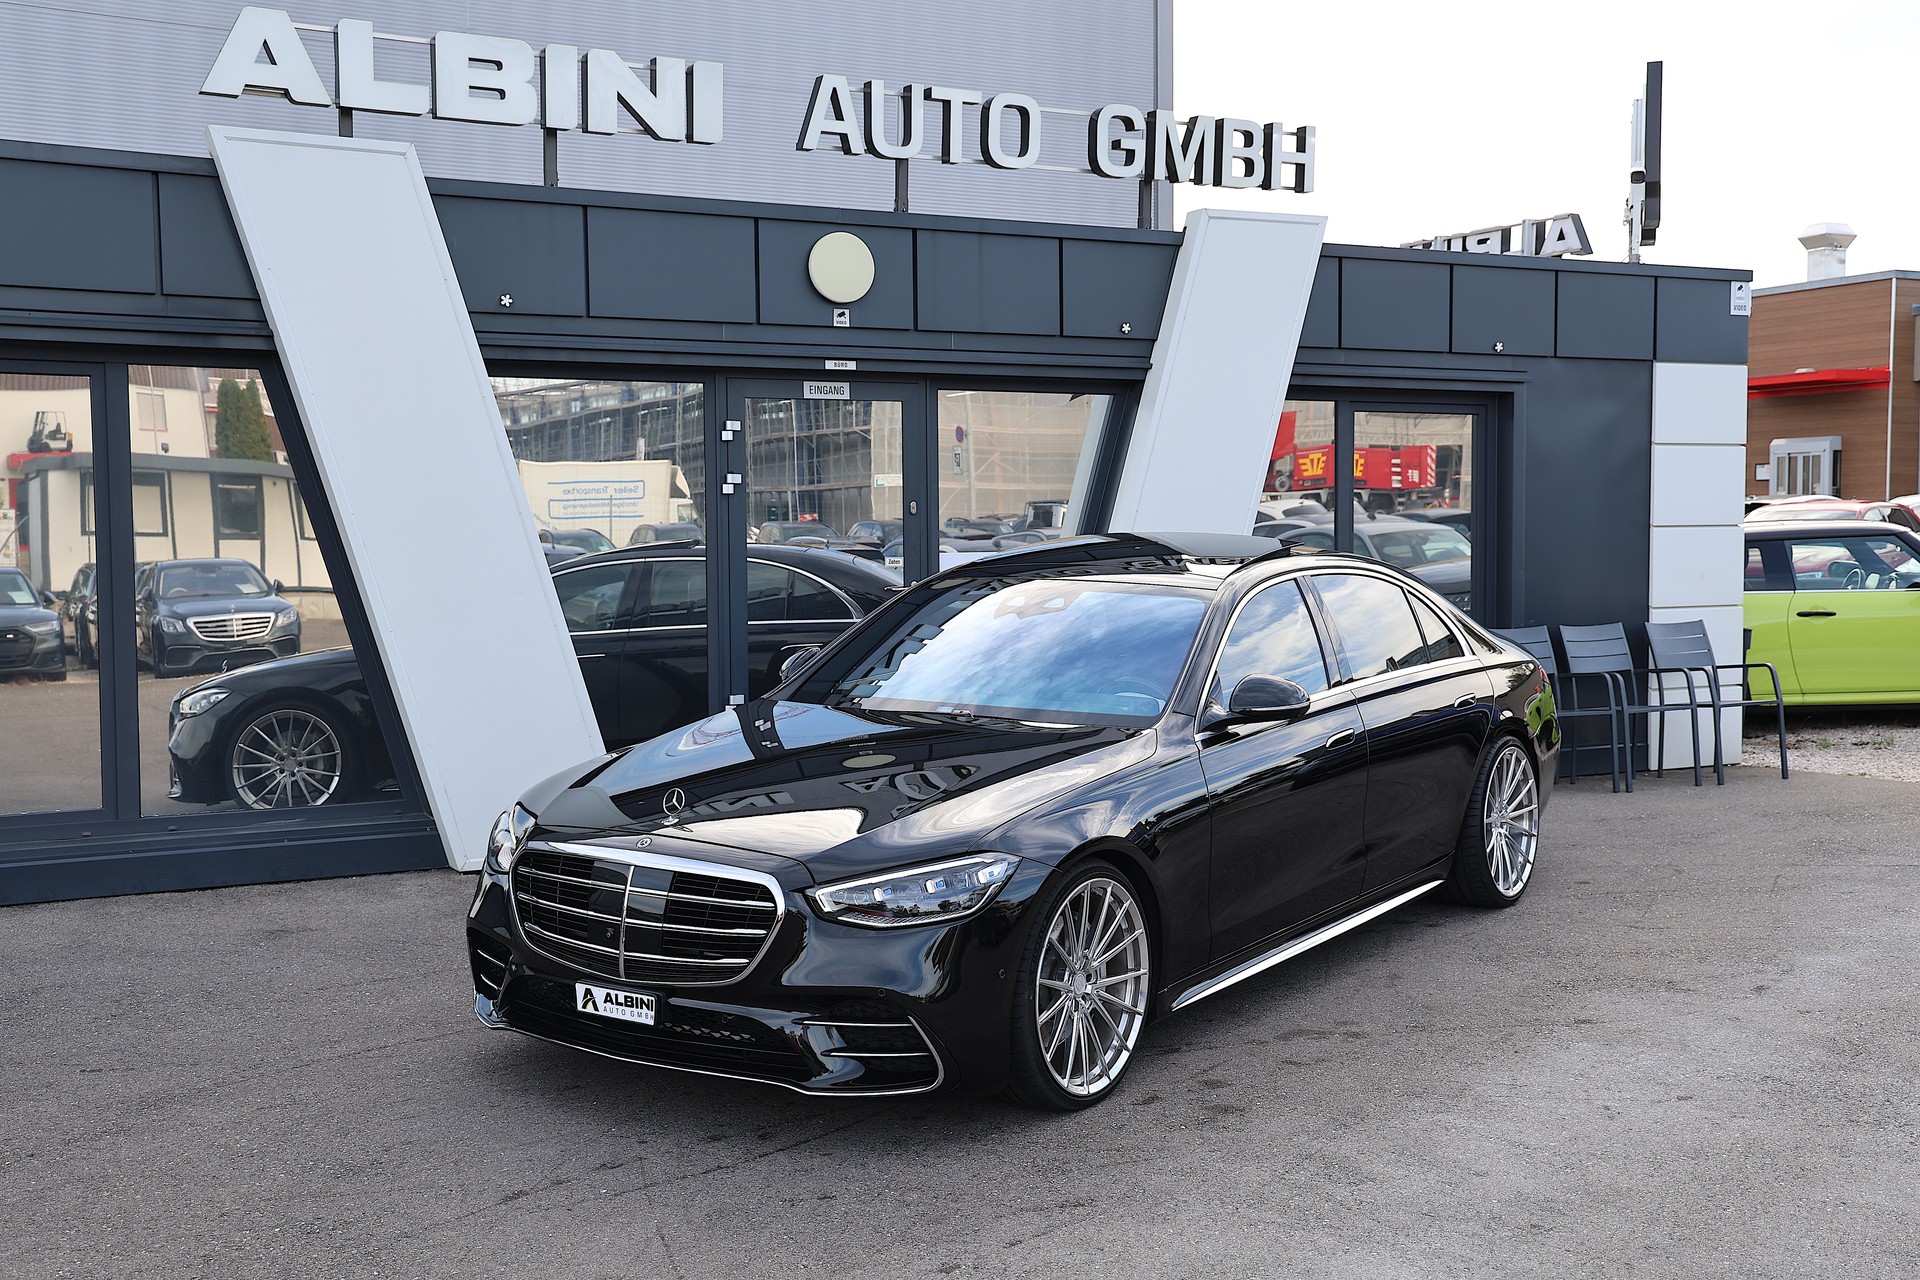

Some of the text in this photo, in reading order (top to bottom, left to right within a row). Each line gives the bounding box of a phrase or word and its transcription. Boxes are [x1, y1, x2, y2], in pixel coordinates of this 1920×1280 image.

[198, 5, 1316, 194] ALBINI AUTO GMBH
[809, 384, 845, 396] EINGANG
[603, 992, 654, 1012] ALBINI
[603, 1005, 626, 1016] AUTO
